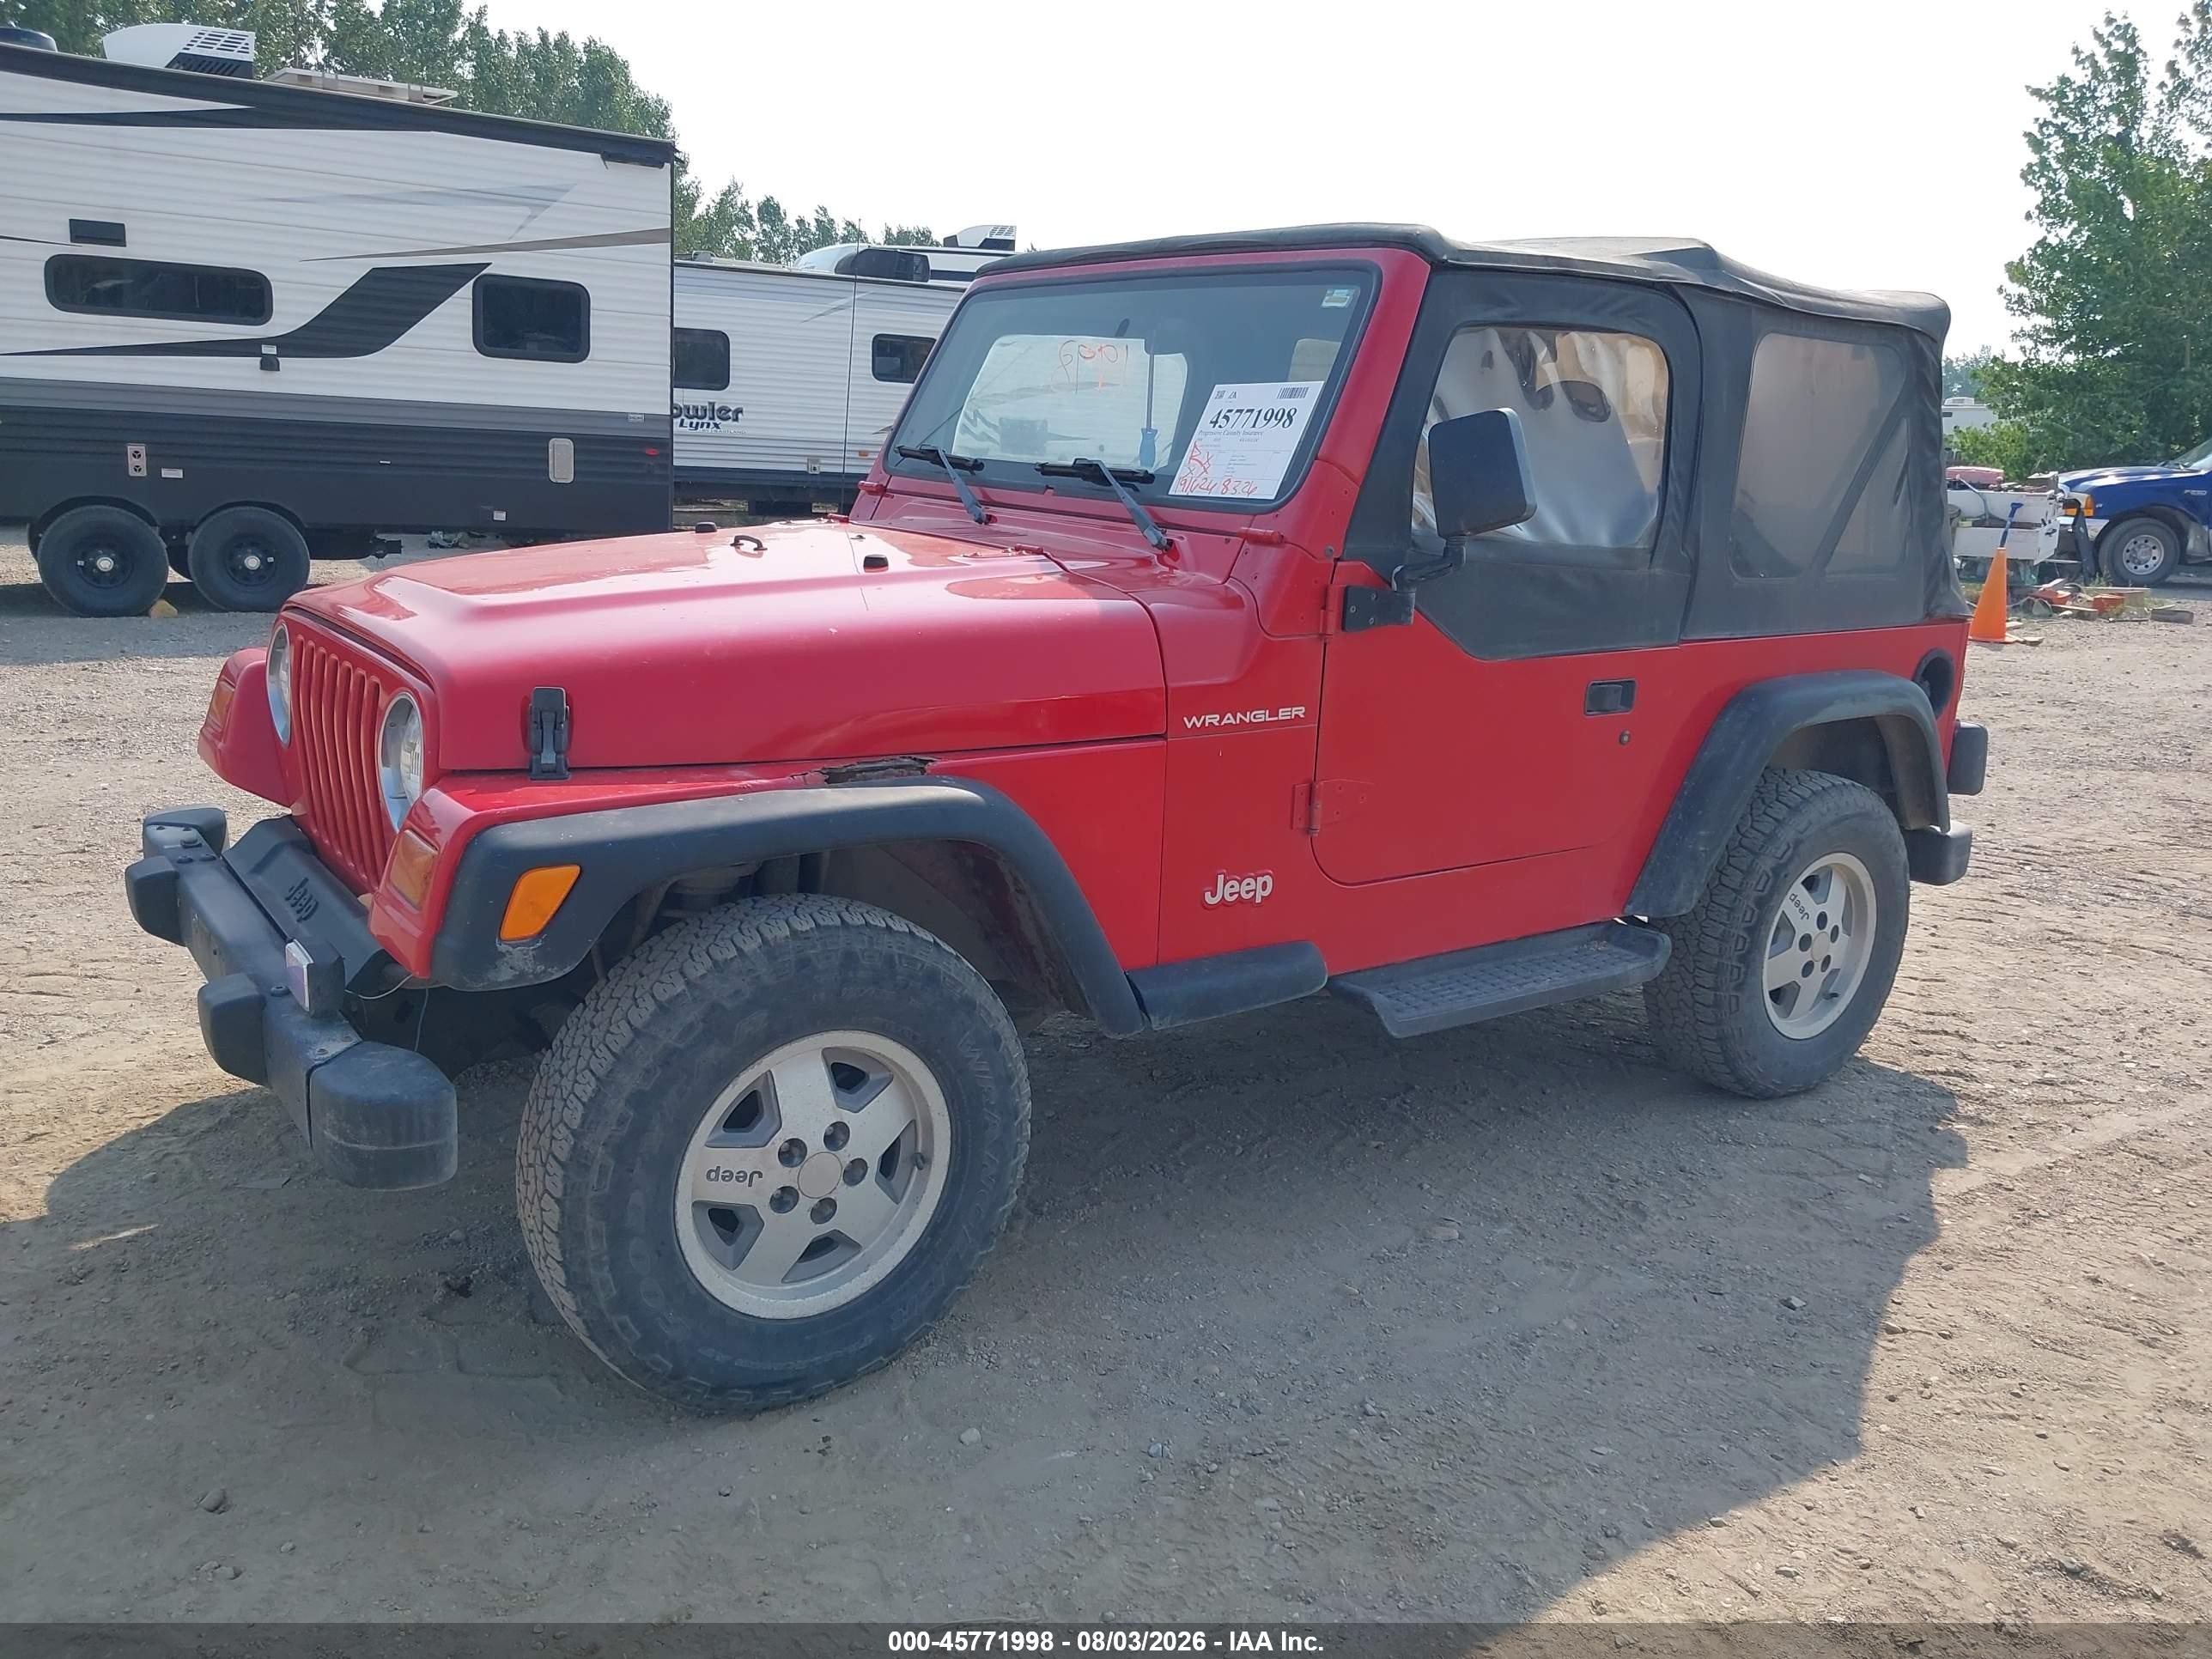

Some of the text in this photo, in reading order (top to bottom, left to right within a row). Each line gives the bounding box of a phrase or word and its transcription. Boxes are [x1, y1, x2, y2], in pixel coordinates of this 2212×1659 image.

[678, 418, 721, 430] Lynx
[1209, 407, 1297, 429] 45771998
[1183, 706, 1305, 729] WRANGLER
[285, 877, 319, 923] Jeep
[1204, 874, 1273, 905] Jeep
[1790, 893, 1809, 920] Jeep
[706, 1165, 763, 1188] Jeep
